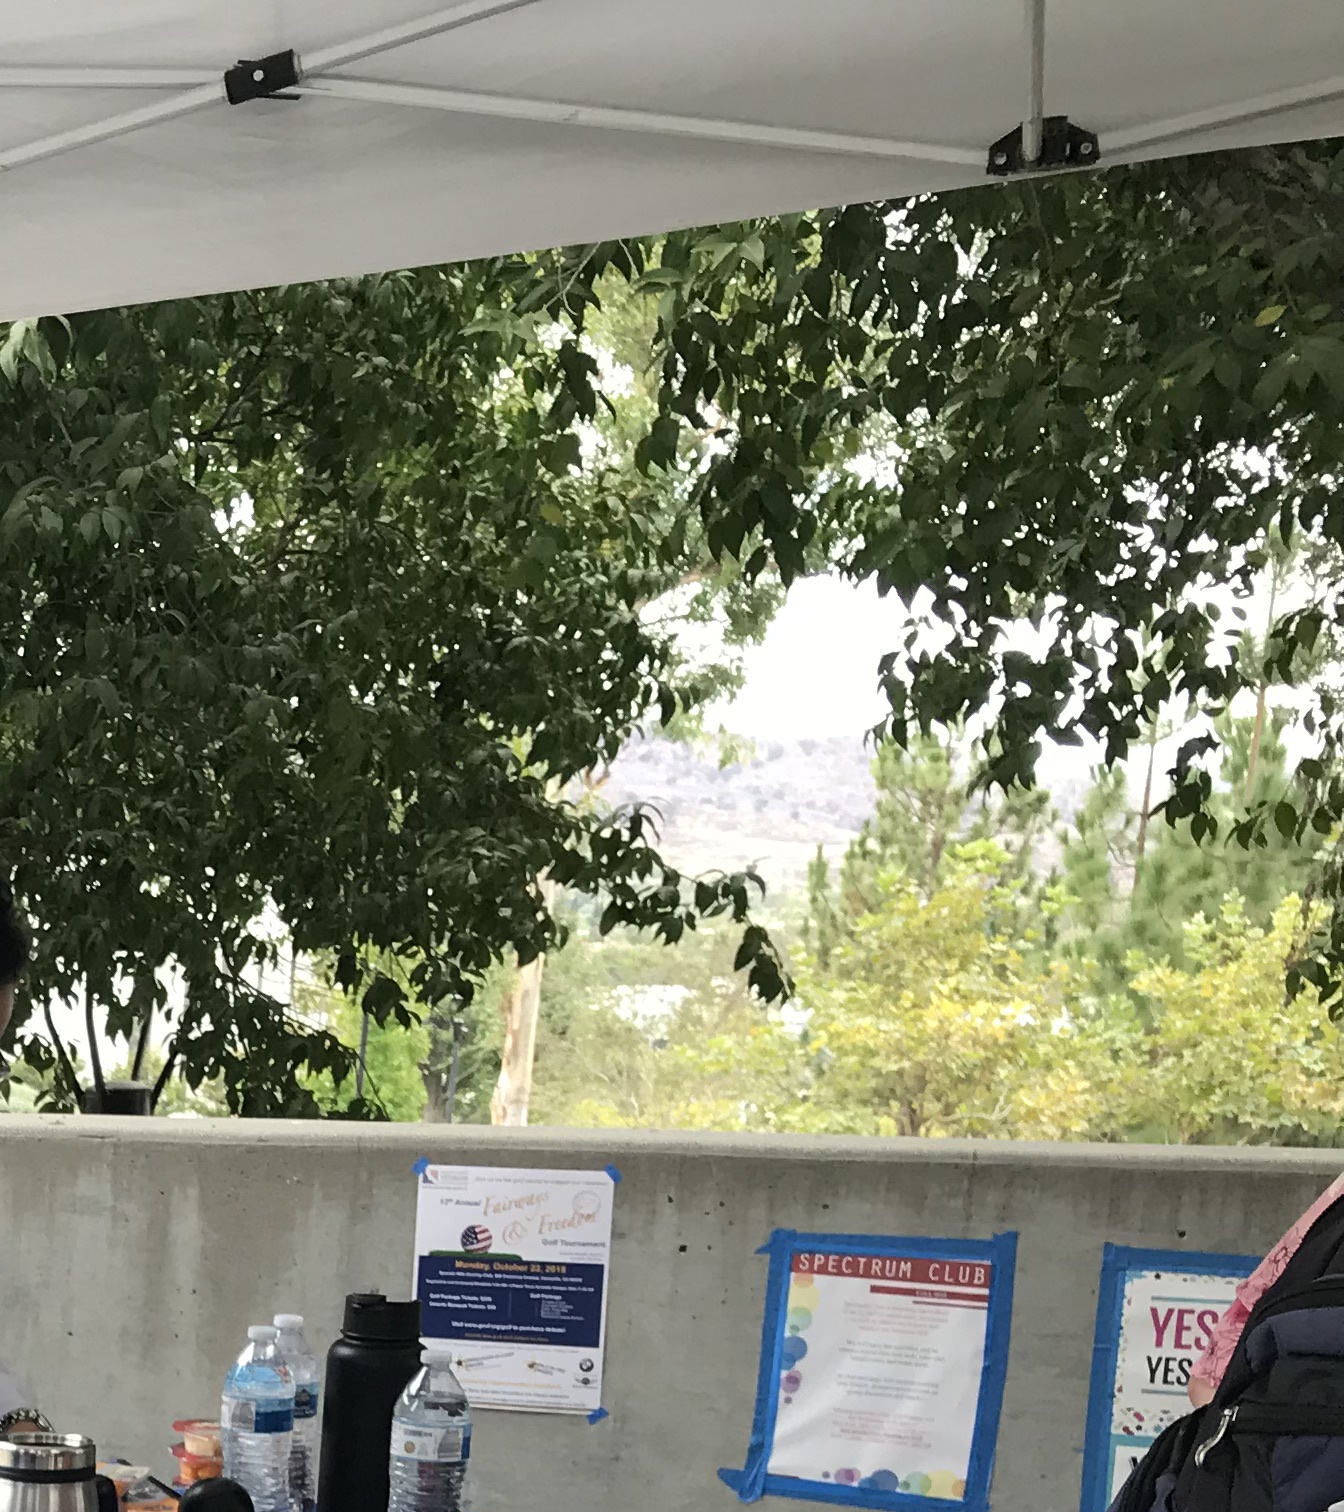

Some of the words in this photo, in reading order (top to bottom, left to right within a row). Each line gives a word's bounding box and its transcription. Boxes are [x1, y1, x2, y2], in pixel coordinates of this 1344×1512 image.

[493, 1262, 529, 1273] October
[799, 1253, 912, 1279] SPECTRUM
[928, 1263, 986, 1285] CLUB
[1150, 1306, 1218, 1351] YES
[1146, 1355, 1193, 1387] YES
